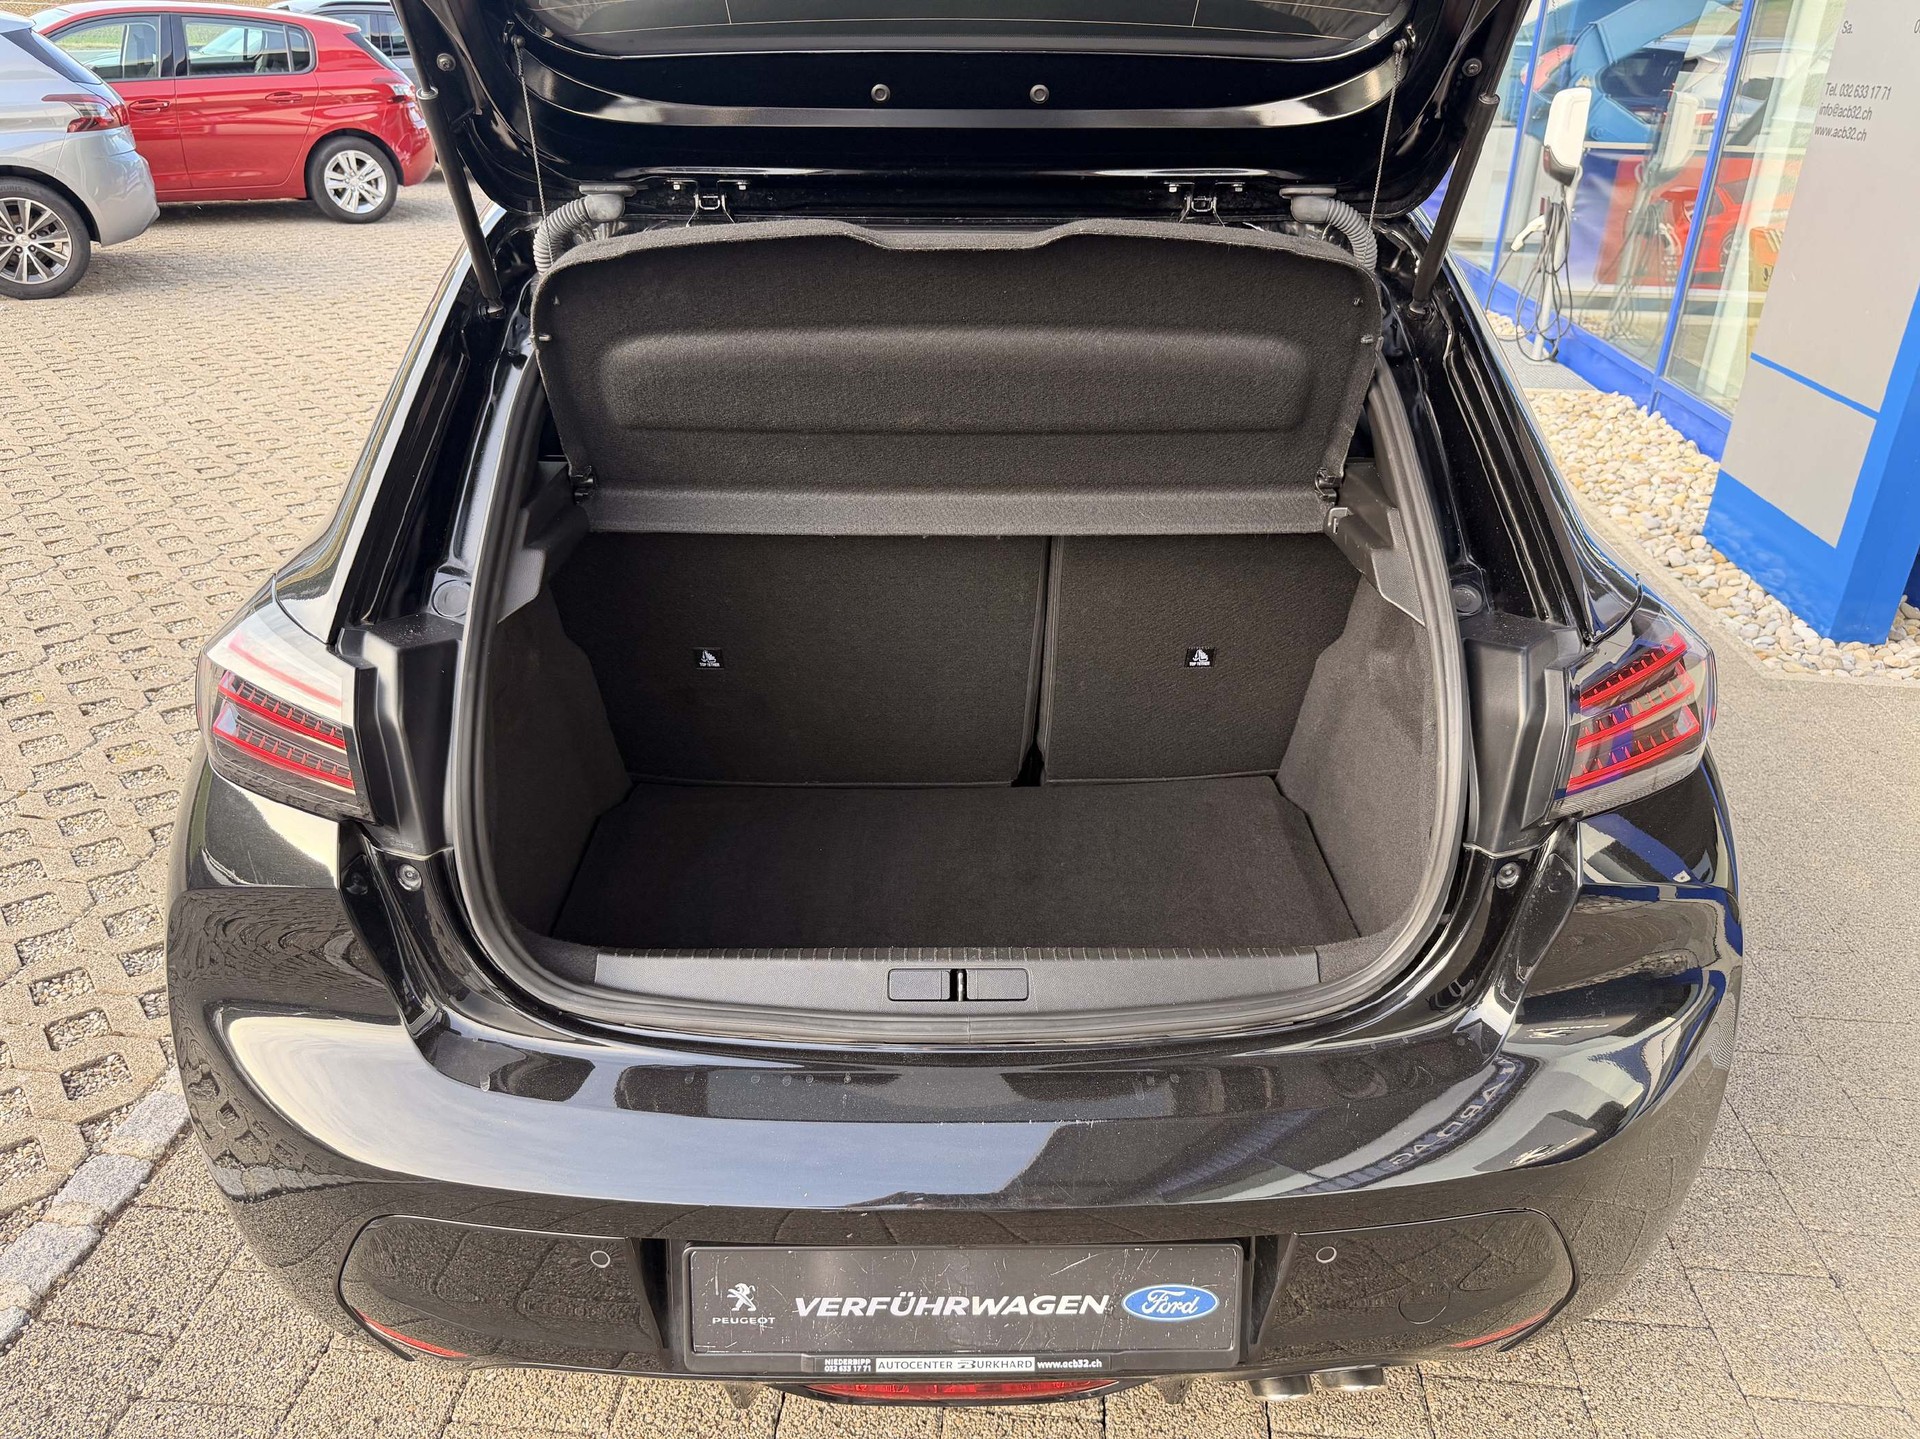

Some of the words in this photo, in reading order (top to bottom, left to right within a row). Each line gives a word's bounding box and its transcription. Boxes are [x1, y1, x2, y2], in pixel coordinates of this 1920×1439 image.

[1841, 20, 1853, 34] Sa.
[1825, 82, 1837, 97] Tel.
[1839, 83, 1853, 98] 032
[1854, 84, 1869, 99] 633
[1870, 85, 1881, 99] 17
[1881, 86, 1892, 100] 71
[1819, 102, 1872, 121] info@acb32.ch
[1814, 126, 1868, 142] www.acb32.ch
[795, 1292, 1110, 1317] VERFÜHRWAGEN
[1141, 1289, 1200, 1315] Ford
[712, 1316, 775, 1325] PEUGEOT
[824, 1358, 871, 1366] NIEDERBIPP
[824, 1365, 838, 1373] 032
[838, 1365, 852, 1373] 633
[853, 1365, 862, 1373] 17
[863, 1365, 871, 1373] 71
[878, 1360, 953, 1370] AUTOCENTER
[957, 1359, 1033, 1370] BURKHARD
[1037, 1359, 1103, 1370] www.acb32.ch
